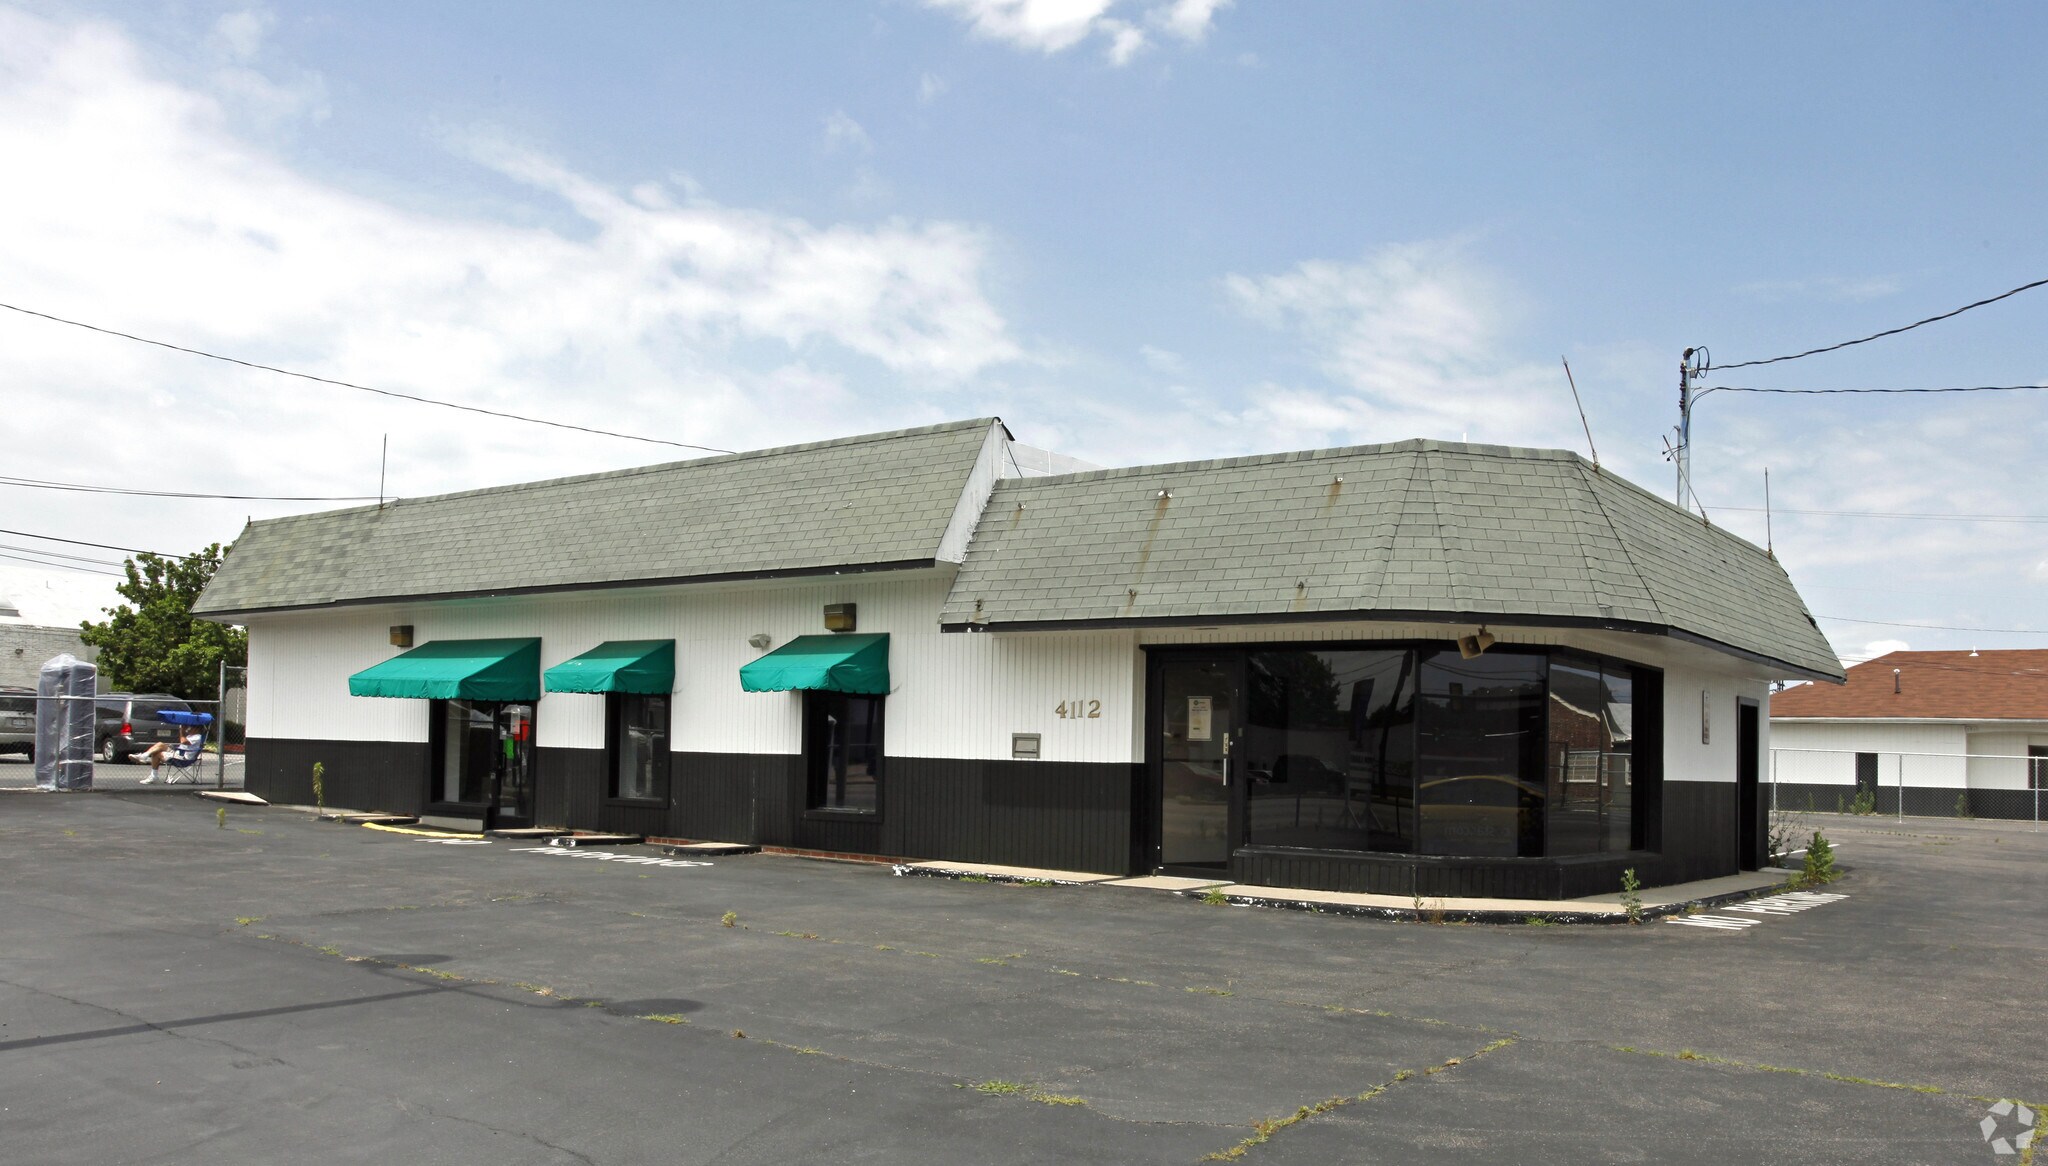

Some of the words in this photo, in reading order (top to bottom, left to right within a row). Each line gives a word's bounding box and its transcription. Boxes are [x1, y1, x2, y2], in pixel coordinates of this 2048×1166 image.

[1055, 699, 1102, 720] 4112
[508, 847, 714, 867] PARKING
[1664, 914, 1763, 931] NO
